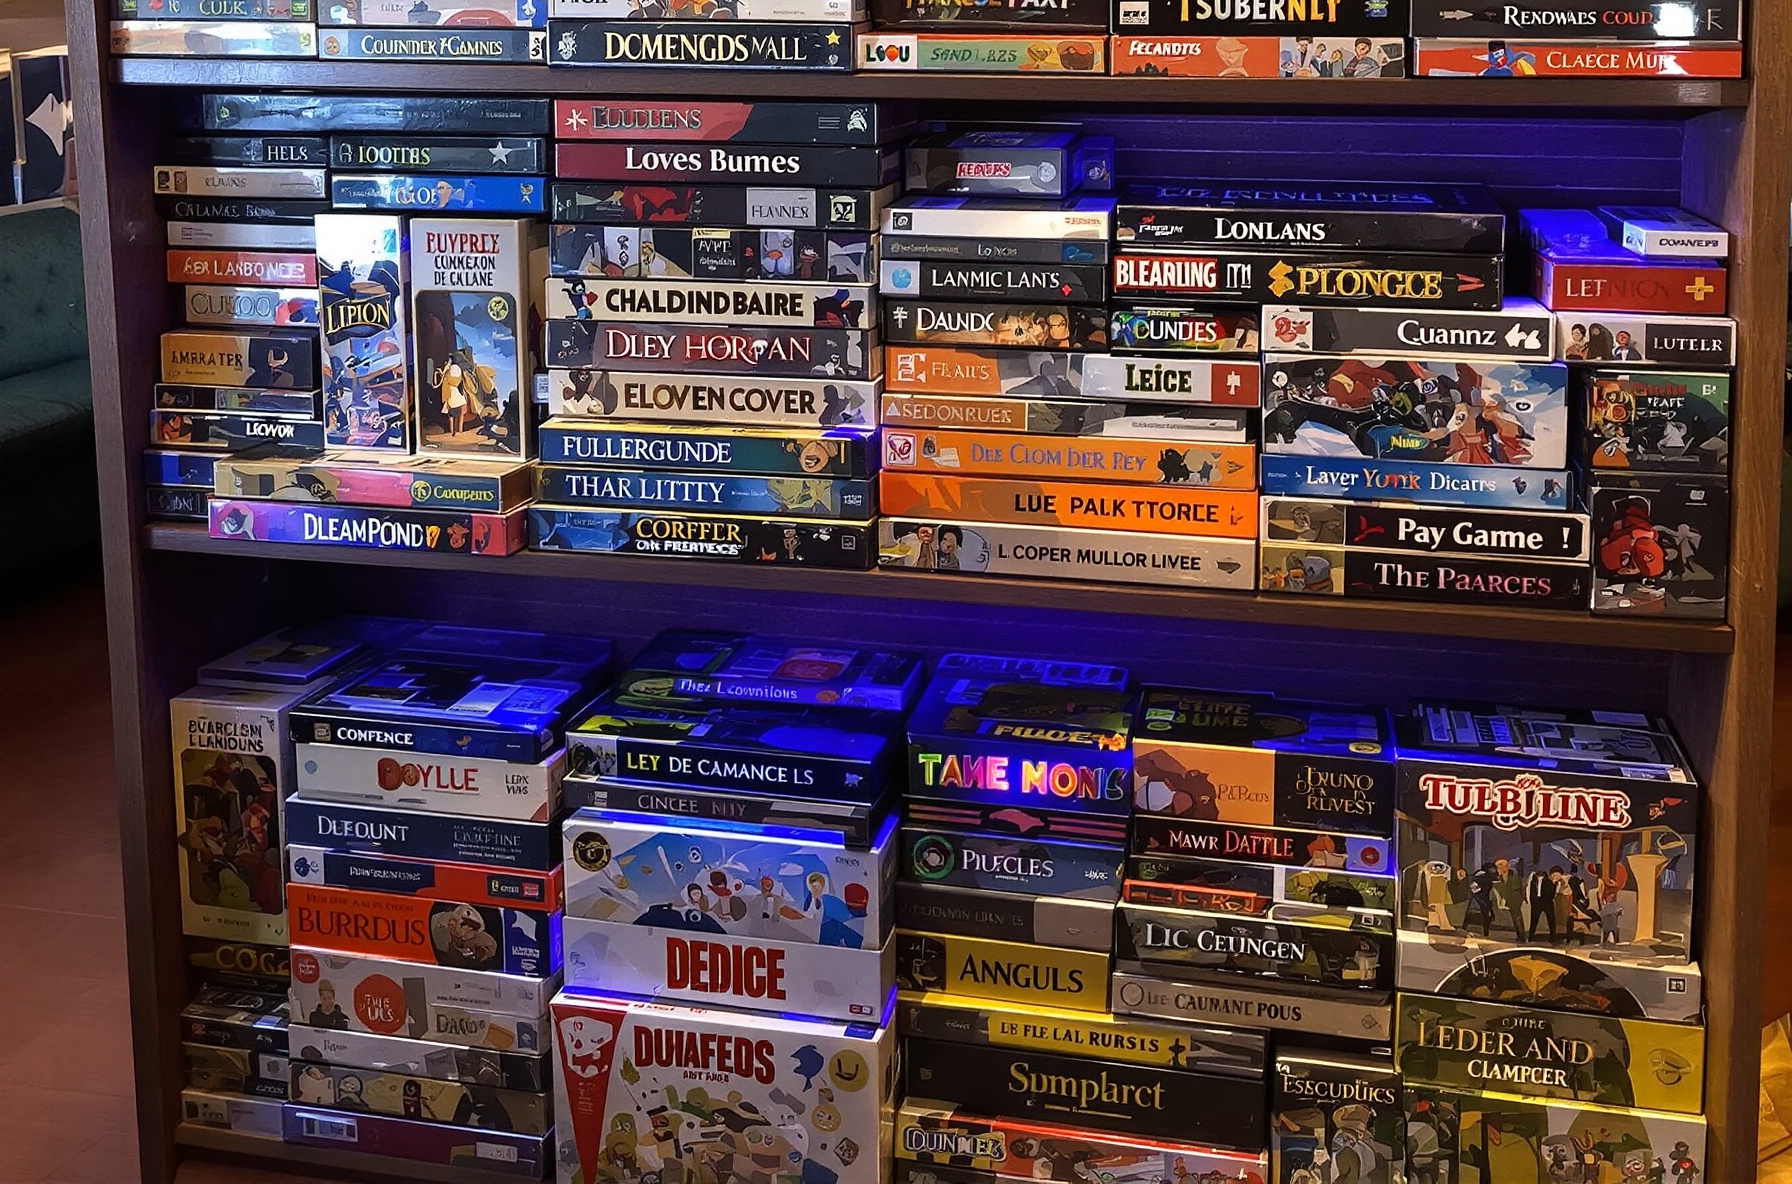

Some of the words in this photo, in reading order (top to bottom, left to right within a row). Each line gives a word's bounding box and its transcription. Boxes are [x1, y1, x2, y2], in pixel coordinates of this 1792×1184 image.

[625, 147, 702, 171] Loves
[728, 387, 816, 415] COVER
[1014, 494, 1057, 514] LUE
[1398, 518, 1446, 549] Pay
[1013, 546, 1071, 564] COPER
[669, 756, 692, 774] DE
[666, 936, 787, 1000] DEDICE
[1527, 1036, 1594, 1067] AND
